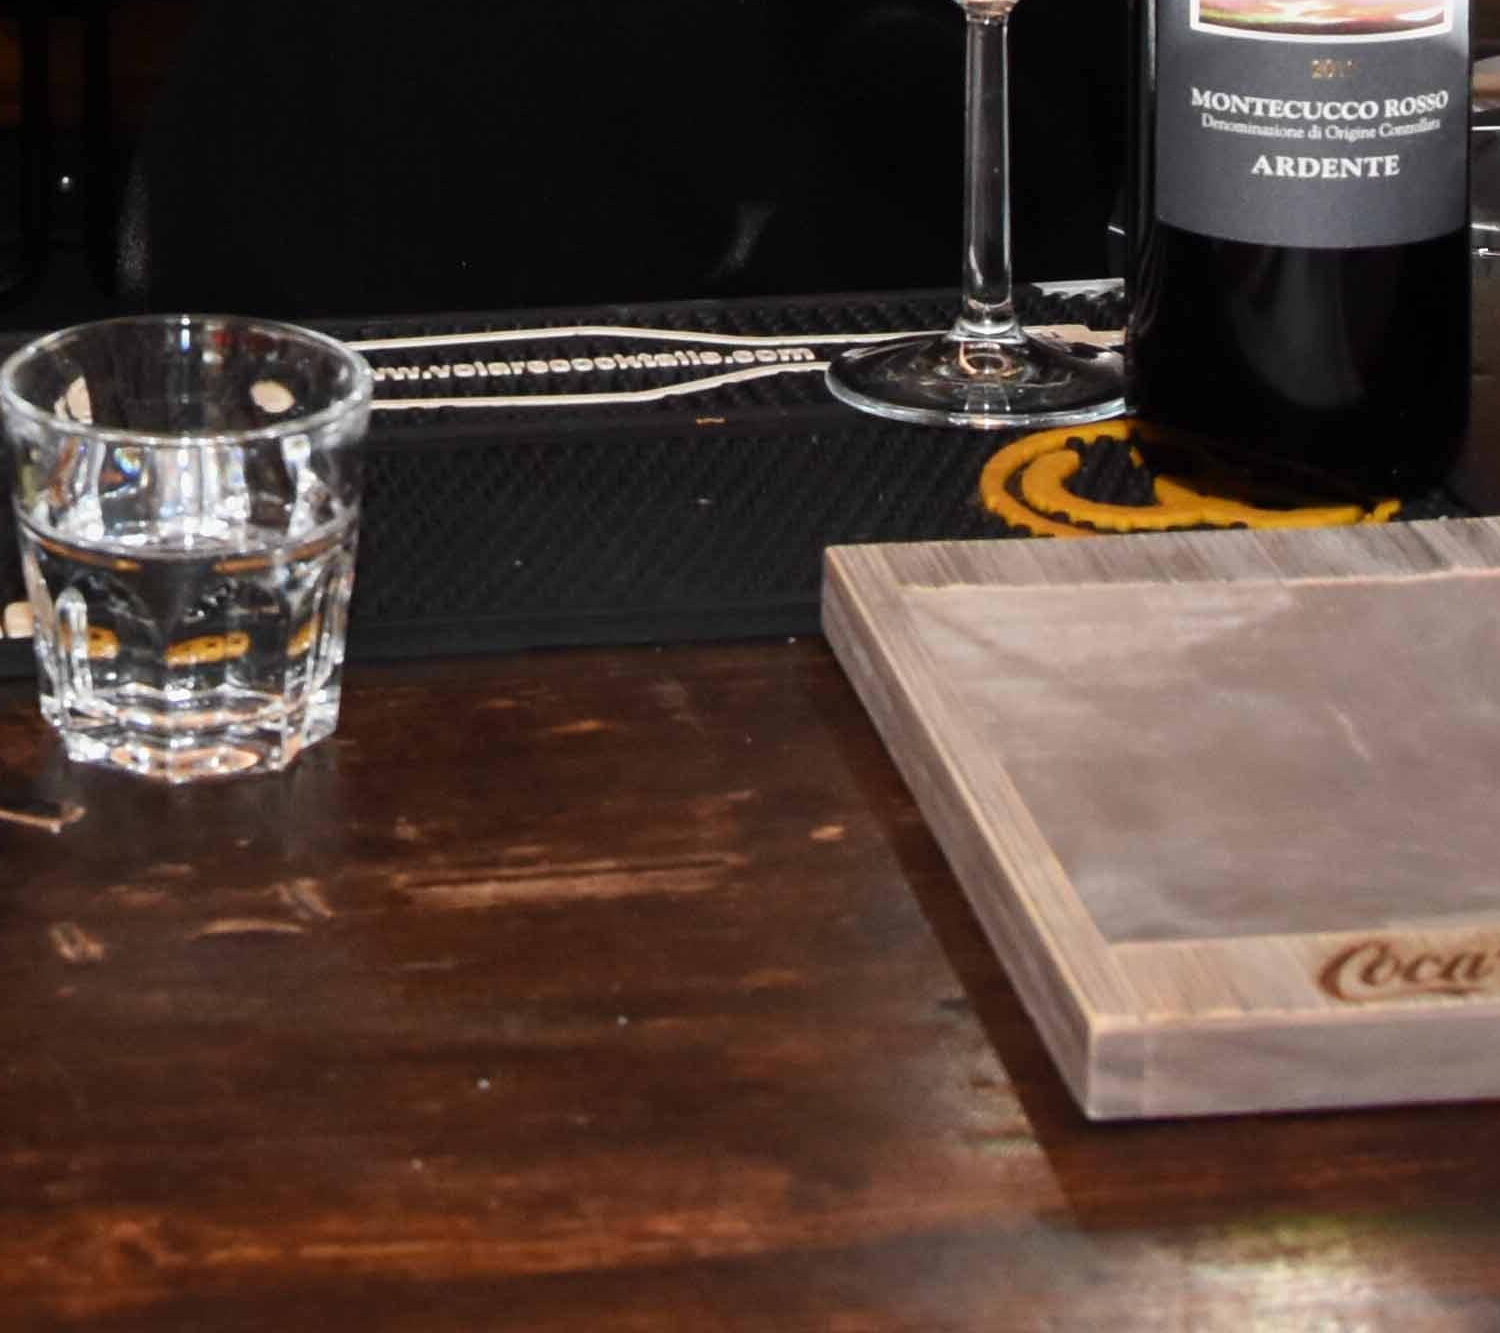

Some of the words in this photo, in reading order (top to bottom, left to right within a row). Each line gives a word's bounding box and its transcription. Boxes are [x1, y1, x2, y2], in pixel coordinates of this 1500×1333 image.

[1190, 86, 1379, 121] MONTECUCCO
[1383, 89, 1450, 118] ROSSO
[1200, 112, 1305, 140] Denominazione
[1307, 124, 1322, 139] di
[1324, 125, 1377, 143] Origine
[1251, 153, 1401, 179] ARDENTE
